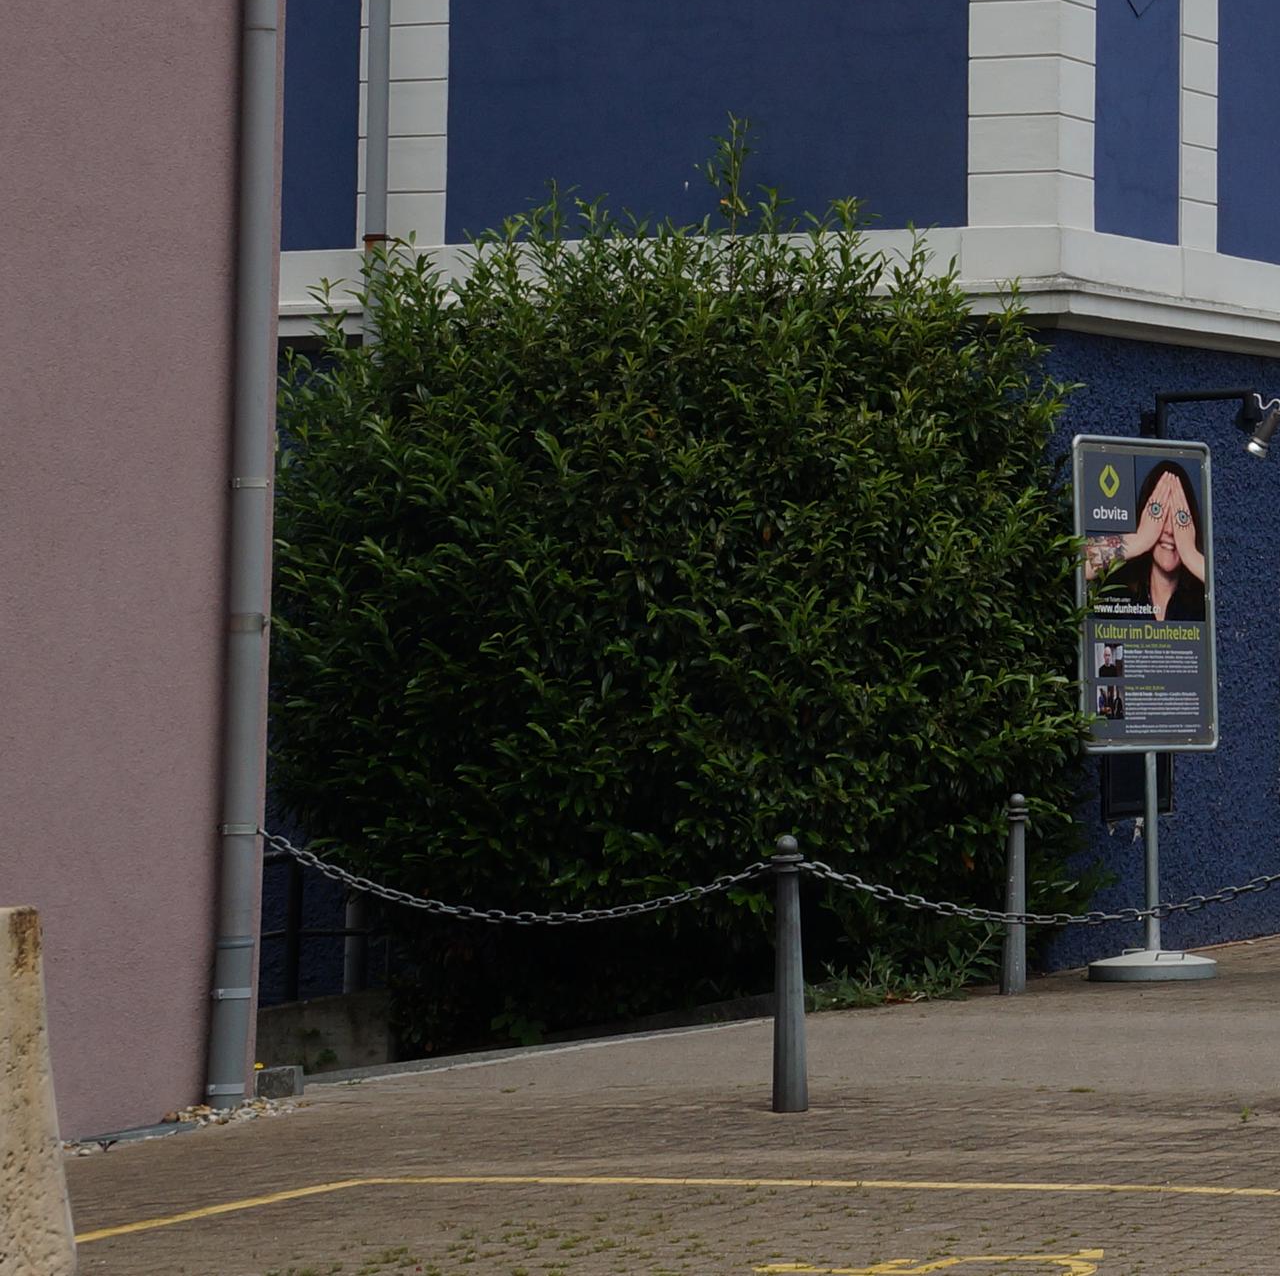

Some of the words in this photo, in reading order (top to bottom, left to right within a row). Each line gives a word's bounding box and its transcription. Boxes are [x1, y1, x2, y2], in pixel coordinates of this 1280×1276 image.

[1092, 505, 1129, 520] obvita
[1094, 623, 1127, 639] Kultur
[1129, 624, 1142, 639] im
[1144, 625, 1200, 640] Dunkelzelt
